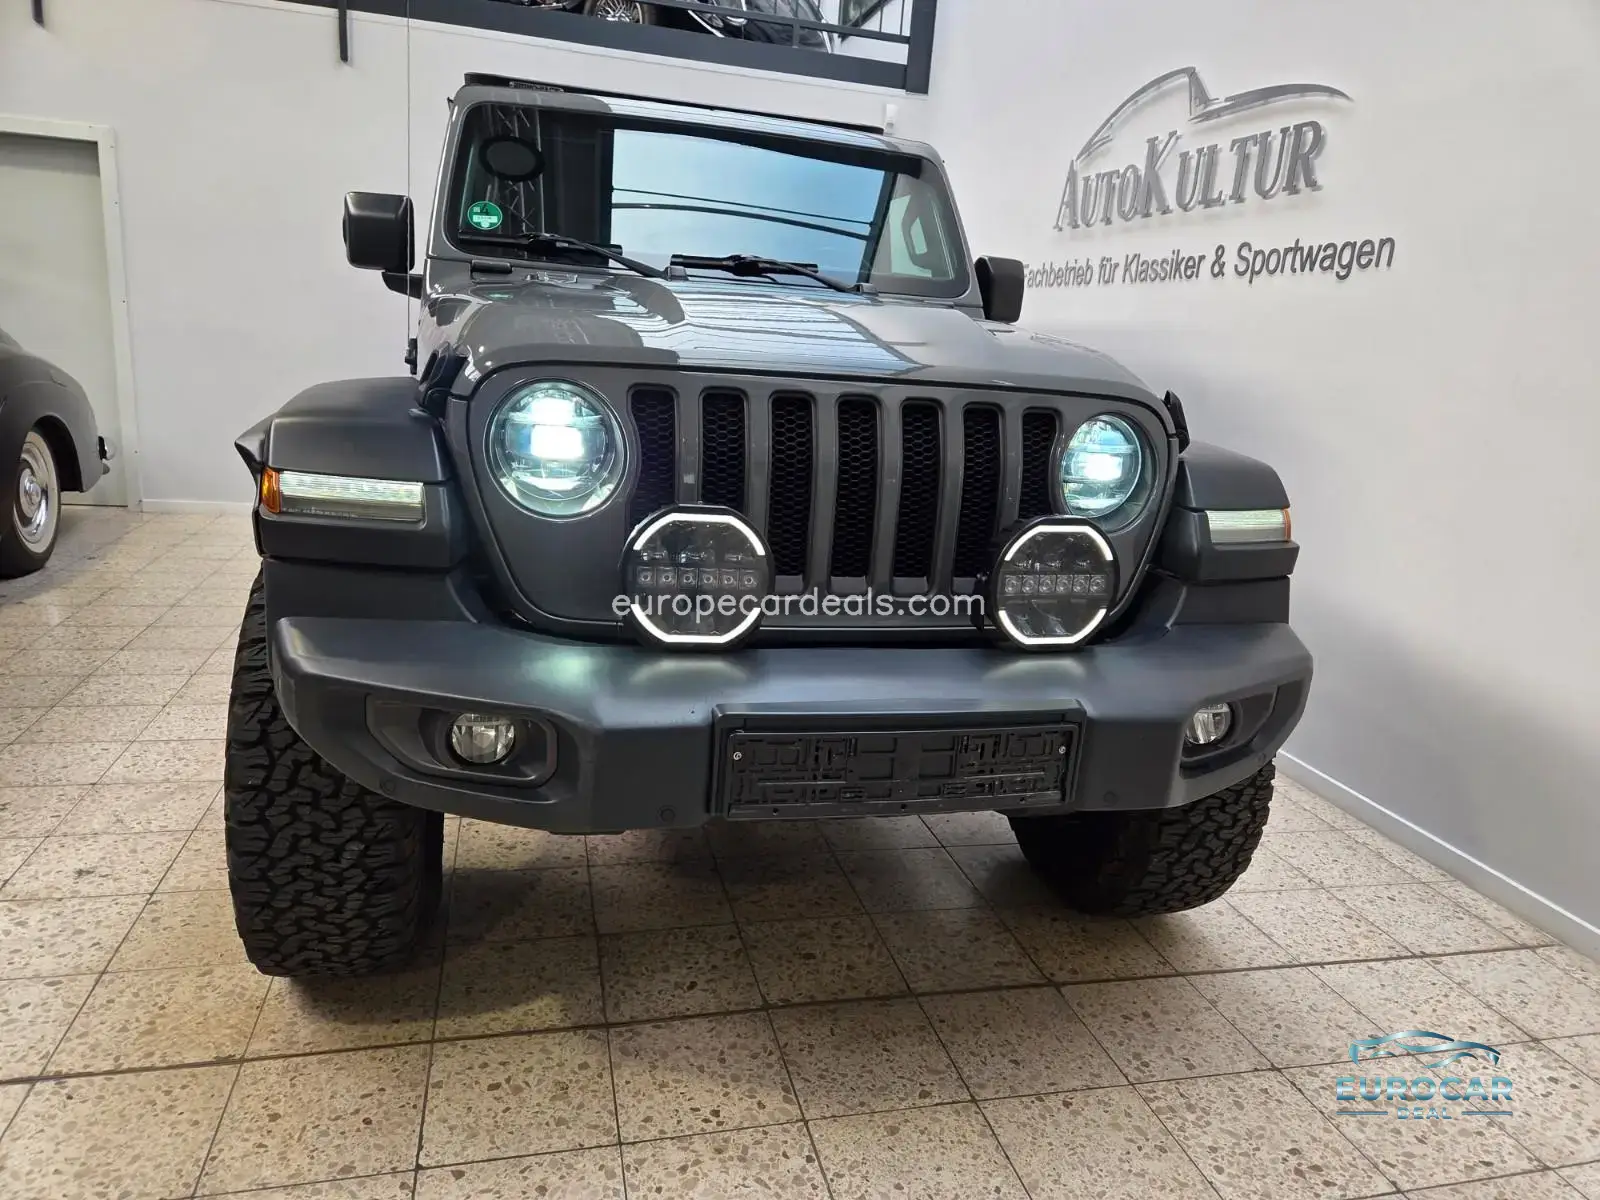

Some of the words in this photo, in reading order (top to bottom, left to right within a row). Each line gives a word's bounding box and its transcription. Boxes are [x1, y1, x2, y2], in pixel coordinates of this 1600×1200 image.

[1098, 256, 1120, 286] für
[1122, 249, 1206, 284] Klassiker
[1210, 244, 1226, 278] &
[1233, 236, 1396, 285] Sportwagen
